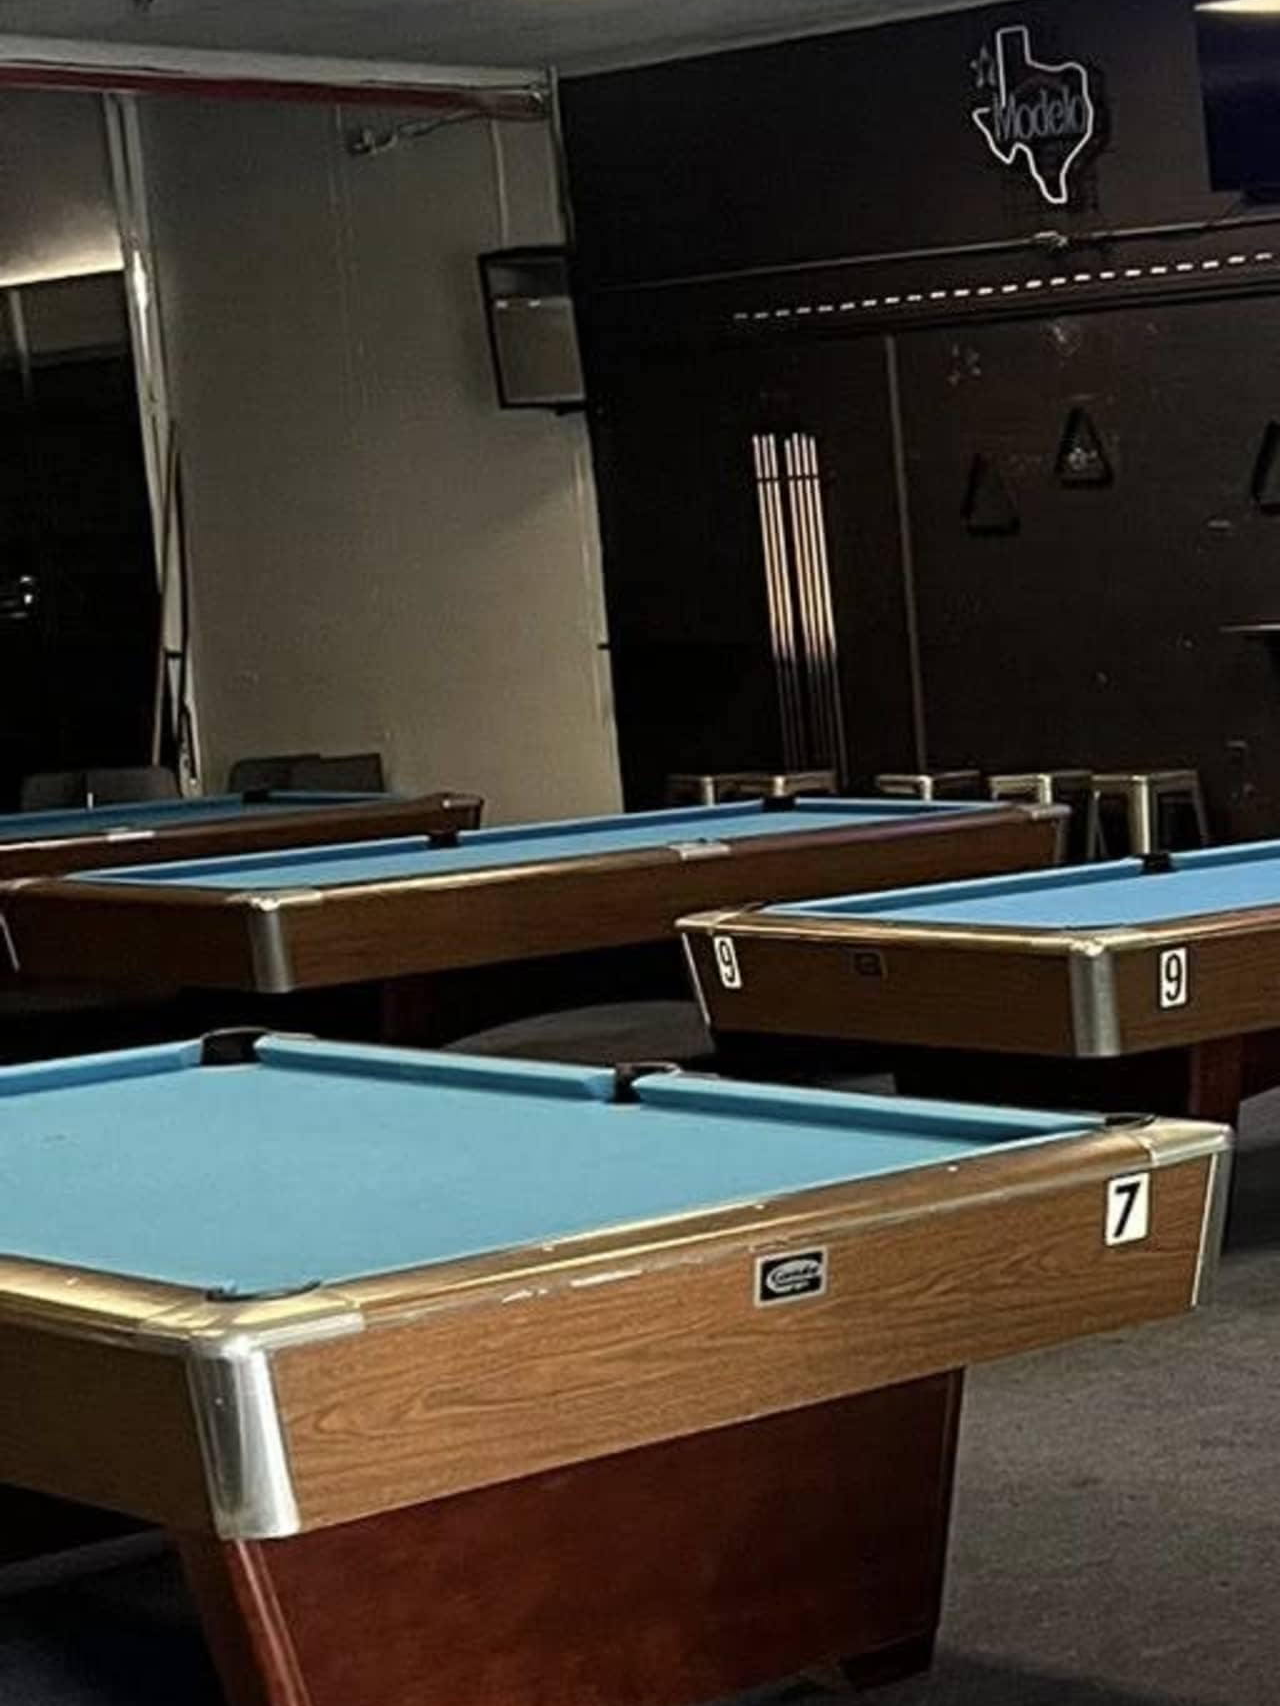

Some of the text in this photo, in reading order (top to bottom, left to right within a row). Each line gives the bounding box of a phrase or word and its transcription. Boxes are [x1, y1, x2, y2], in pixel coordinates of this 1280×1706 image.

[993, 84, 1086, 141] Modelo
[720, 942, 736, 984] 9
[1166, 955, 1181, 1000] 9
[1113, 1182, 1142, 1238] 7
